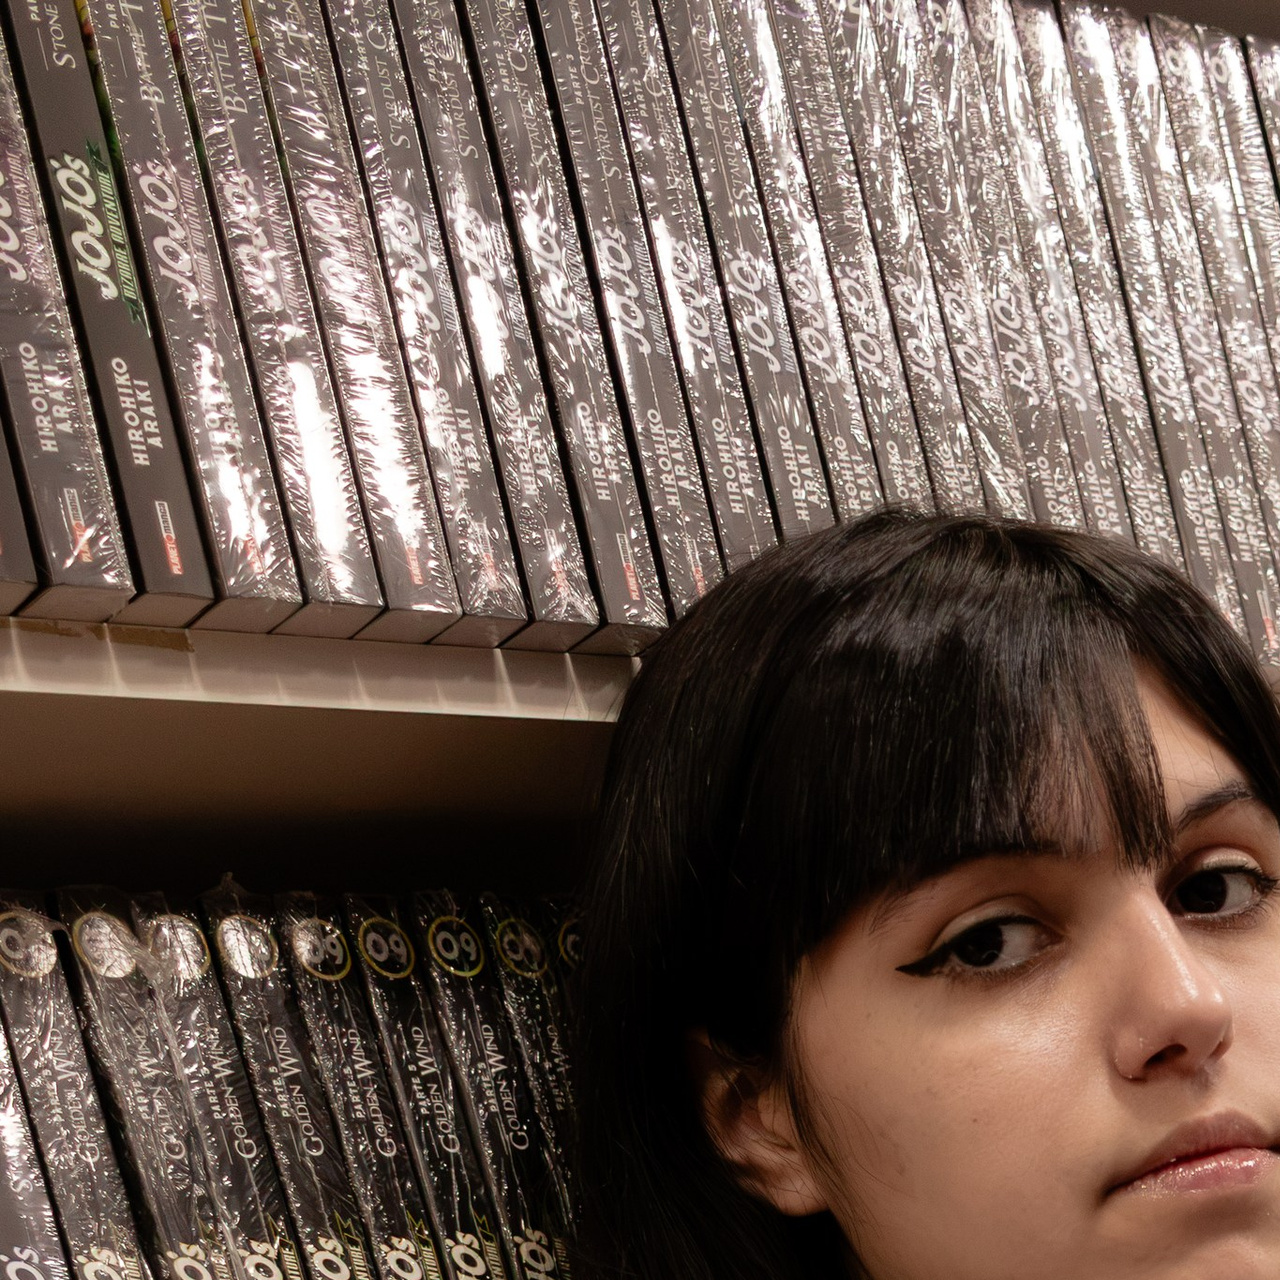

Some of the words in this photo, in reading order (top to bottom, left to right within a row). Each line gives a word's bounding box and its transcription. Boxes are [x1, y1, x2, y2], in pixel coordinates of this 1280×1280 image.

[44, 2, 76, 69] STONE
[212, 38, 247, 113] BATTLE
[376, 55, 411, 148] STARDUST
[495, 53, 512, 92] PARTE
[568, 67, 584, 105] PARTE
[632, 78, 649, 117] PARTE
[444, 71, 478, 158] STARDUST
[587, 94, 622, 180] STARDUST
[714, 114, 748, 200] STARDUST
[96, 170, 125, 244] ADVENTURE
[113, 245, 137, 300] BIZARRE
[19, 342, 58, 452] HIROHIKO
[111, 357, 150, 466] HIROHIKO
[136, 379, 163, 449] ARAKI
[577, 401, 611, 500] HIROHIKO
[647, 409, 681, 507] HIROHIKO
[668, 428, 692, 490] ARAKI
[712, 417, 745, 514] HIROHIKO
[777, 426, 810, 521] HIROHIKO
[796, 445, 821, 505] ARAKI
[165, 541, 183, 575] PLANET
[366, 931, 407, 963] 09
[436, 930, 477, 961] 09
[207, 1028, 234, 1080] WIND
[273, 1027, 301, 1077] WIND
[348, 1029, 375, 1079] WIND
[412, 1026, 440, 1076] WIND
[482, 1024, 507, 1073] WIND
[206, 1080, 224, 1120] PARTE
[224, 1086, 257, 1159] GOLDEN
[273, 1079, 291, 1118] PARTE
[290, 1085, 324, 1157] GOLDEN
[364, 1087, 397, 1157] GOLDEN
[411, 1076, 429, 1116] PARTE
[428, 1083, 460, 1154] GOLDEN
[497, 1082, 529, 1151] GOLDEN
